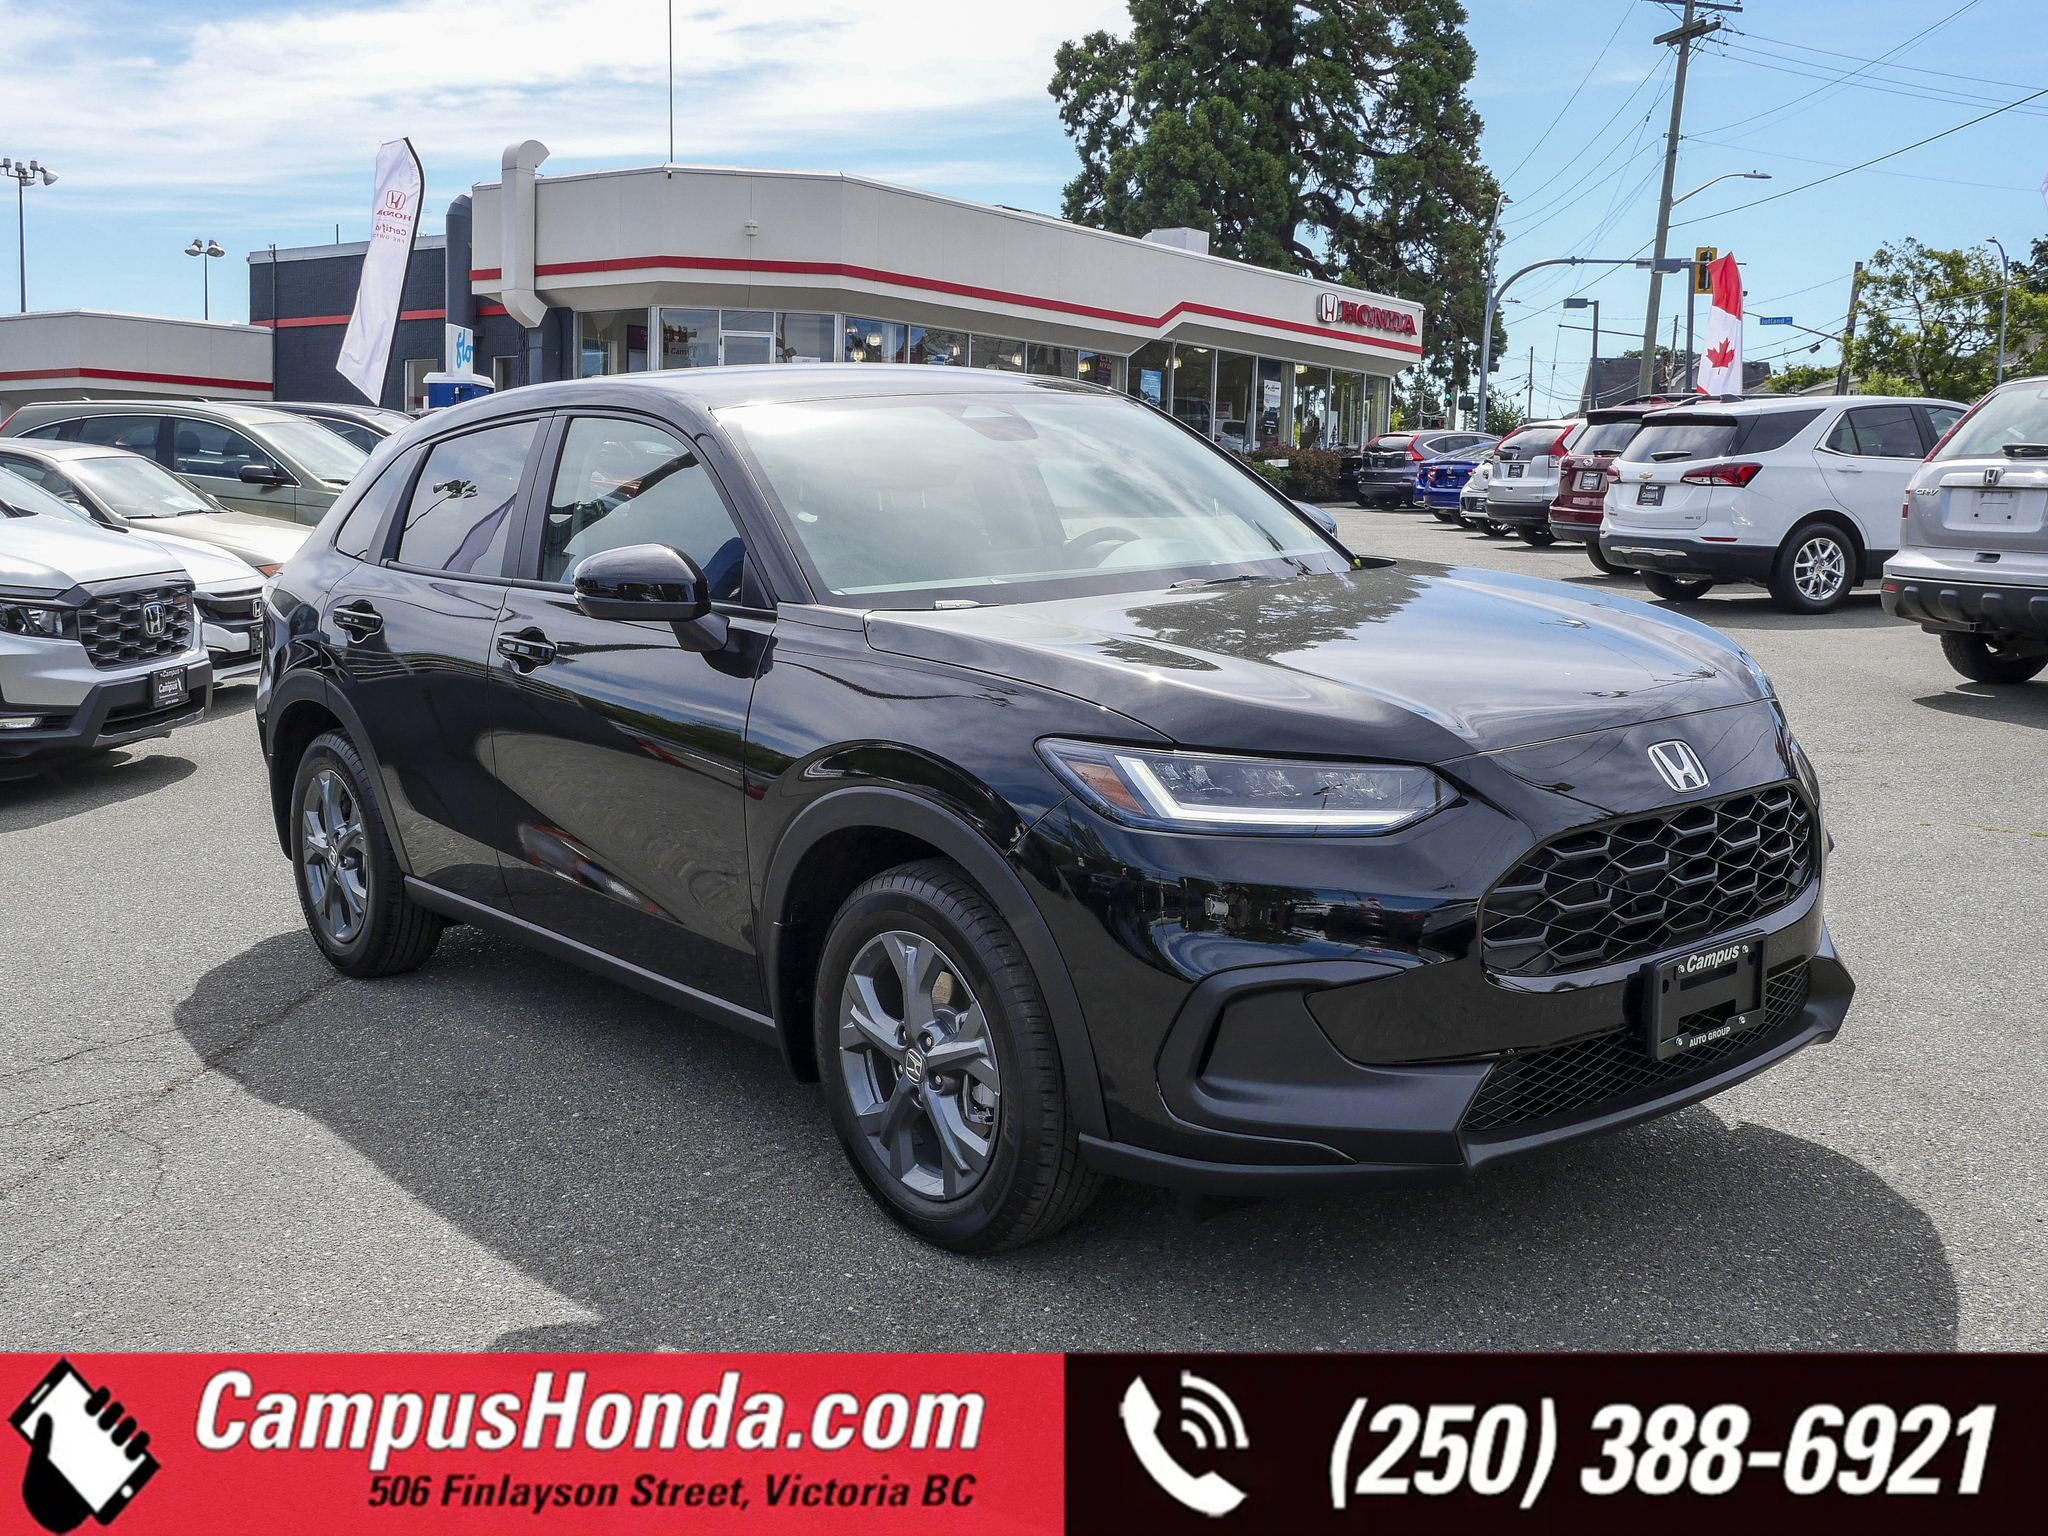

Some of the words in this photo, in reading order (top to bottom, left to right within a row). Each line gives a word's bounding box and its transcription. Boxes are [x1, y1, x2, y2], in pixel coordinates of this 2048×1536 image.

[1340, 300, 1418, 336] HONDA
[456, 328, 474, 369] flo
[1915, 488, 1939, 496] CR-V
[1686, 945, 1740, 973] Campus
[1688, 1034, 1707, 1048] AUTO
[1707, 1026, 1731, 1041] GROUP
